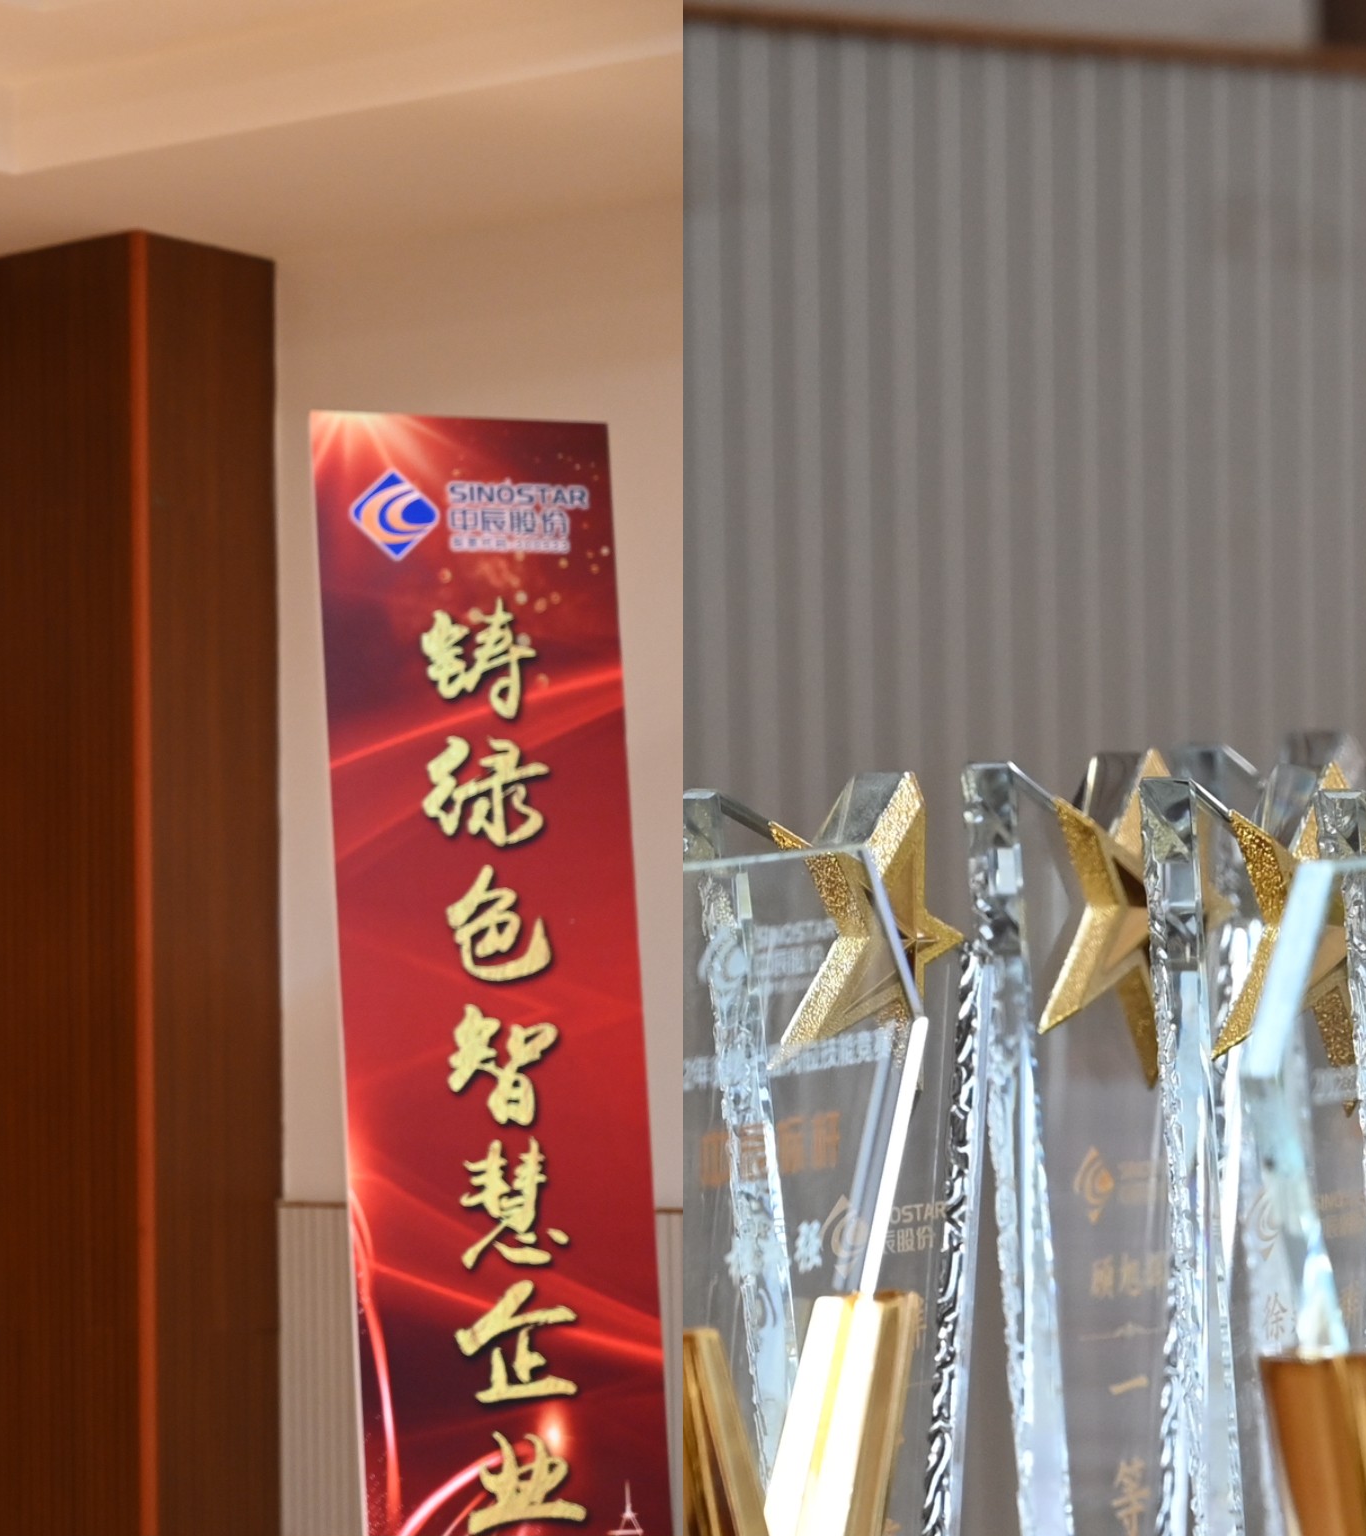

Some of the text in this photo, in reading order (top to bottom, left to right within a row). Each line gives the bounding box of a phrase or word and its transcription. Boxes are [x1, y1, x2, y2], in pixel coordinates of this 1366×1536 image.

[449, 483, 587, 507] SINOSTAR
[449, 506, 569, 535] 中辰股份
[421, 597, 587, 1536] 铸绿色智慧企业
